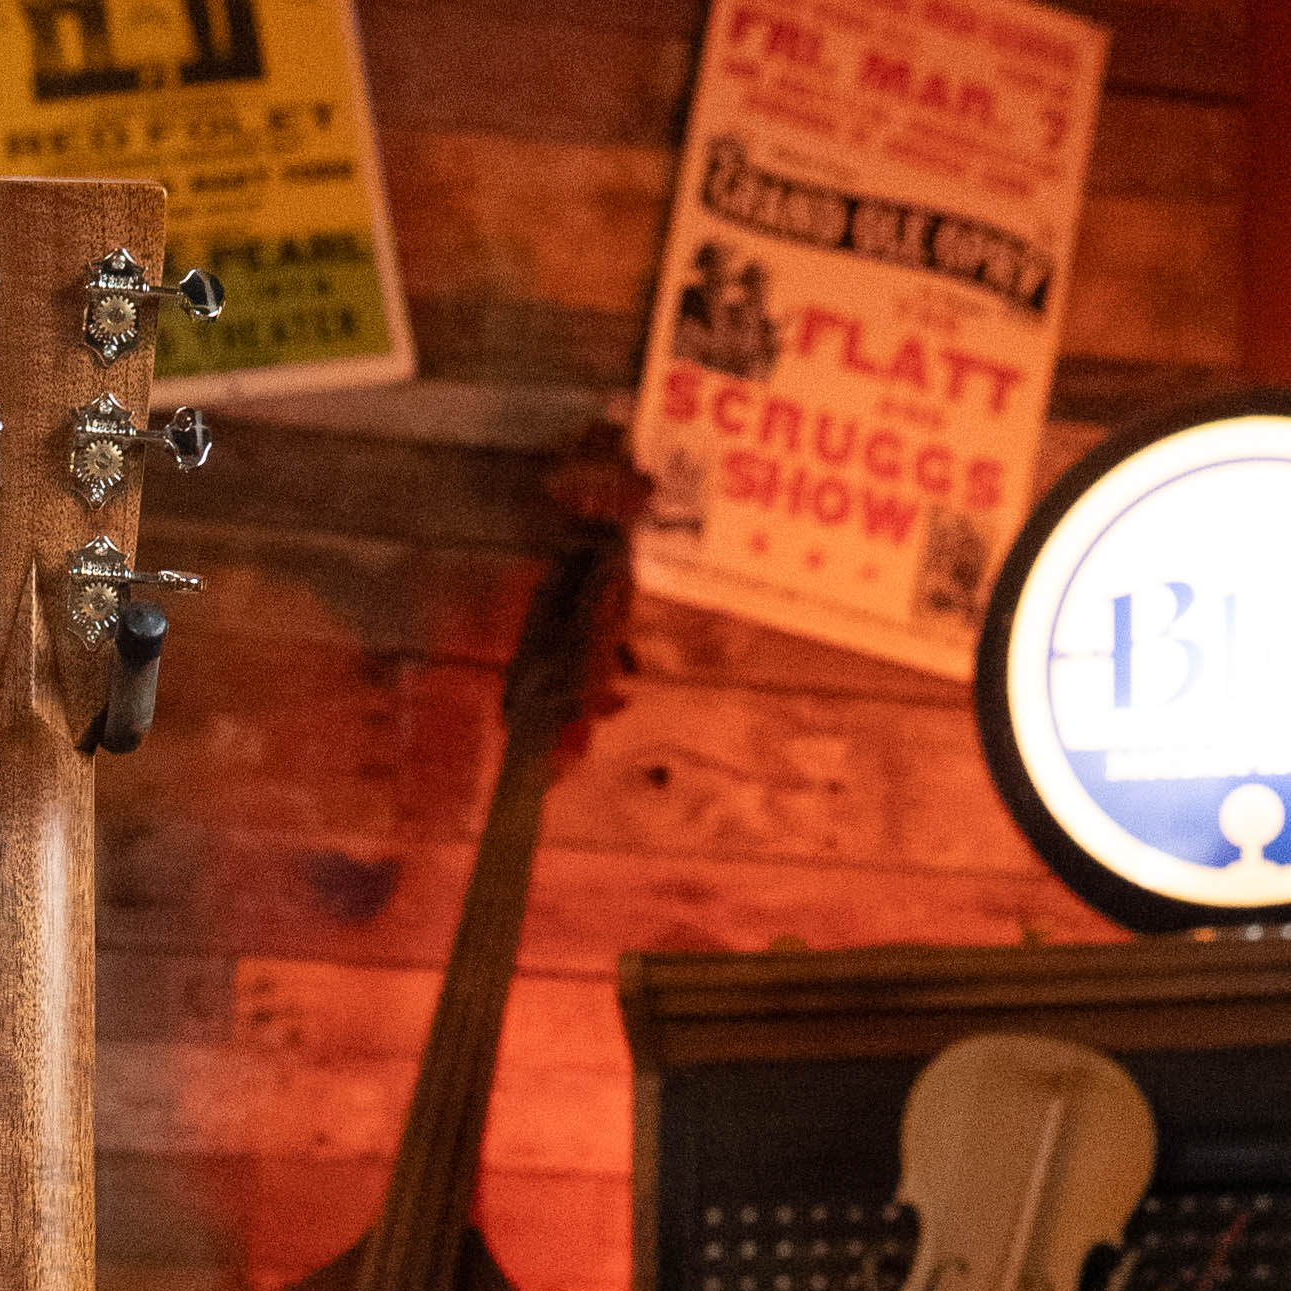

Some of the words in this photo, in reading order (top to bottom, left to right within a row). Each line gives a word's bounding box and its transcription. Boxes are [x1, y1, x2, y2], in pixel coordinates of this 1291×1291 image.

[796, 308, 1024, 418] FLATT
[662, 367, 1004, 512] SCRUGGS
[721, 449, 921, 546] SHOW
